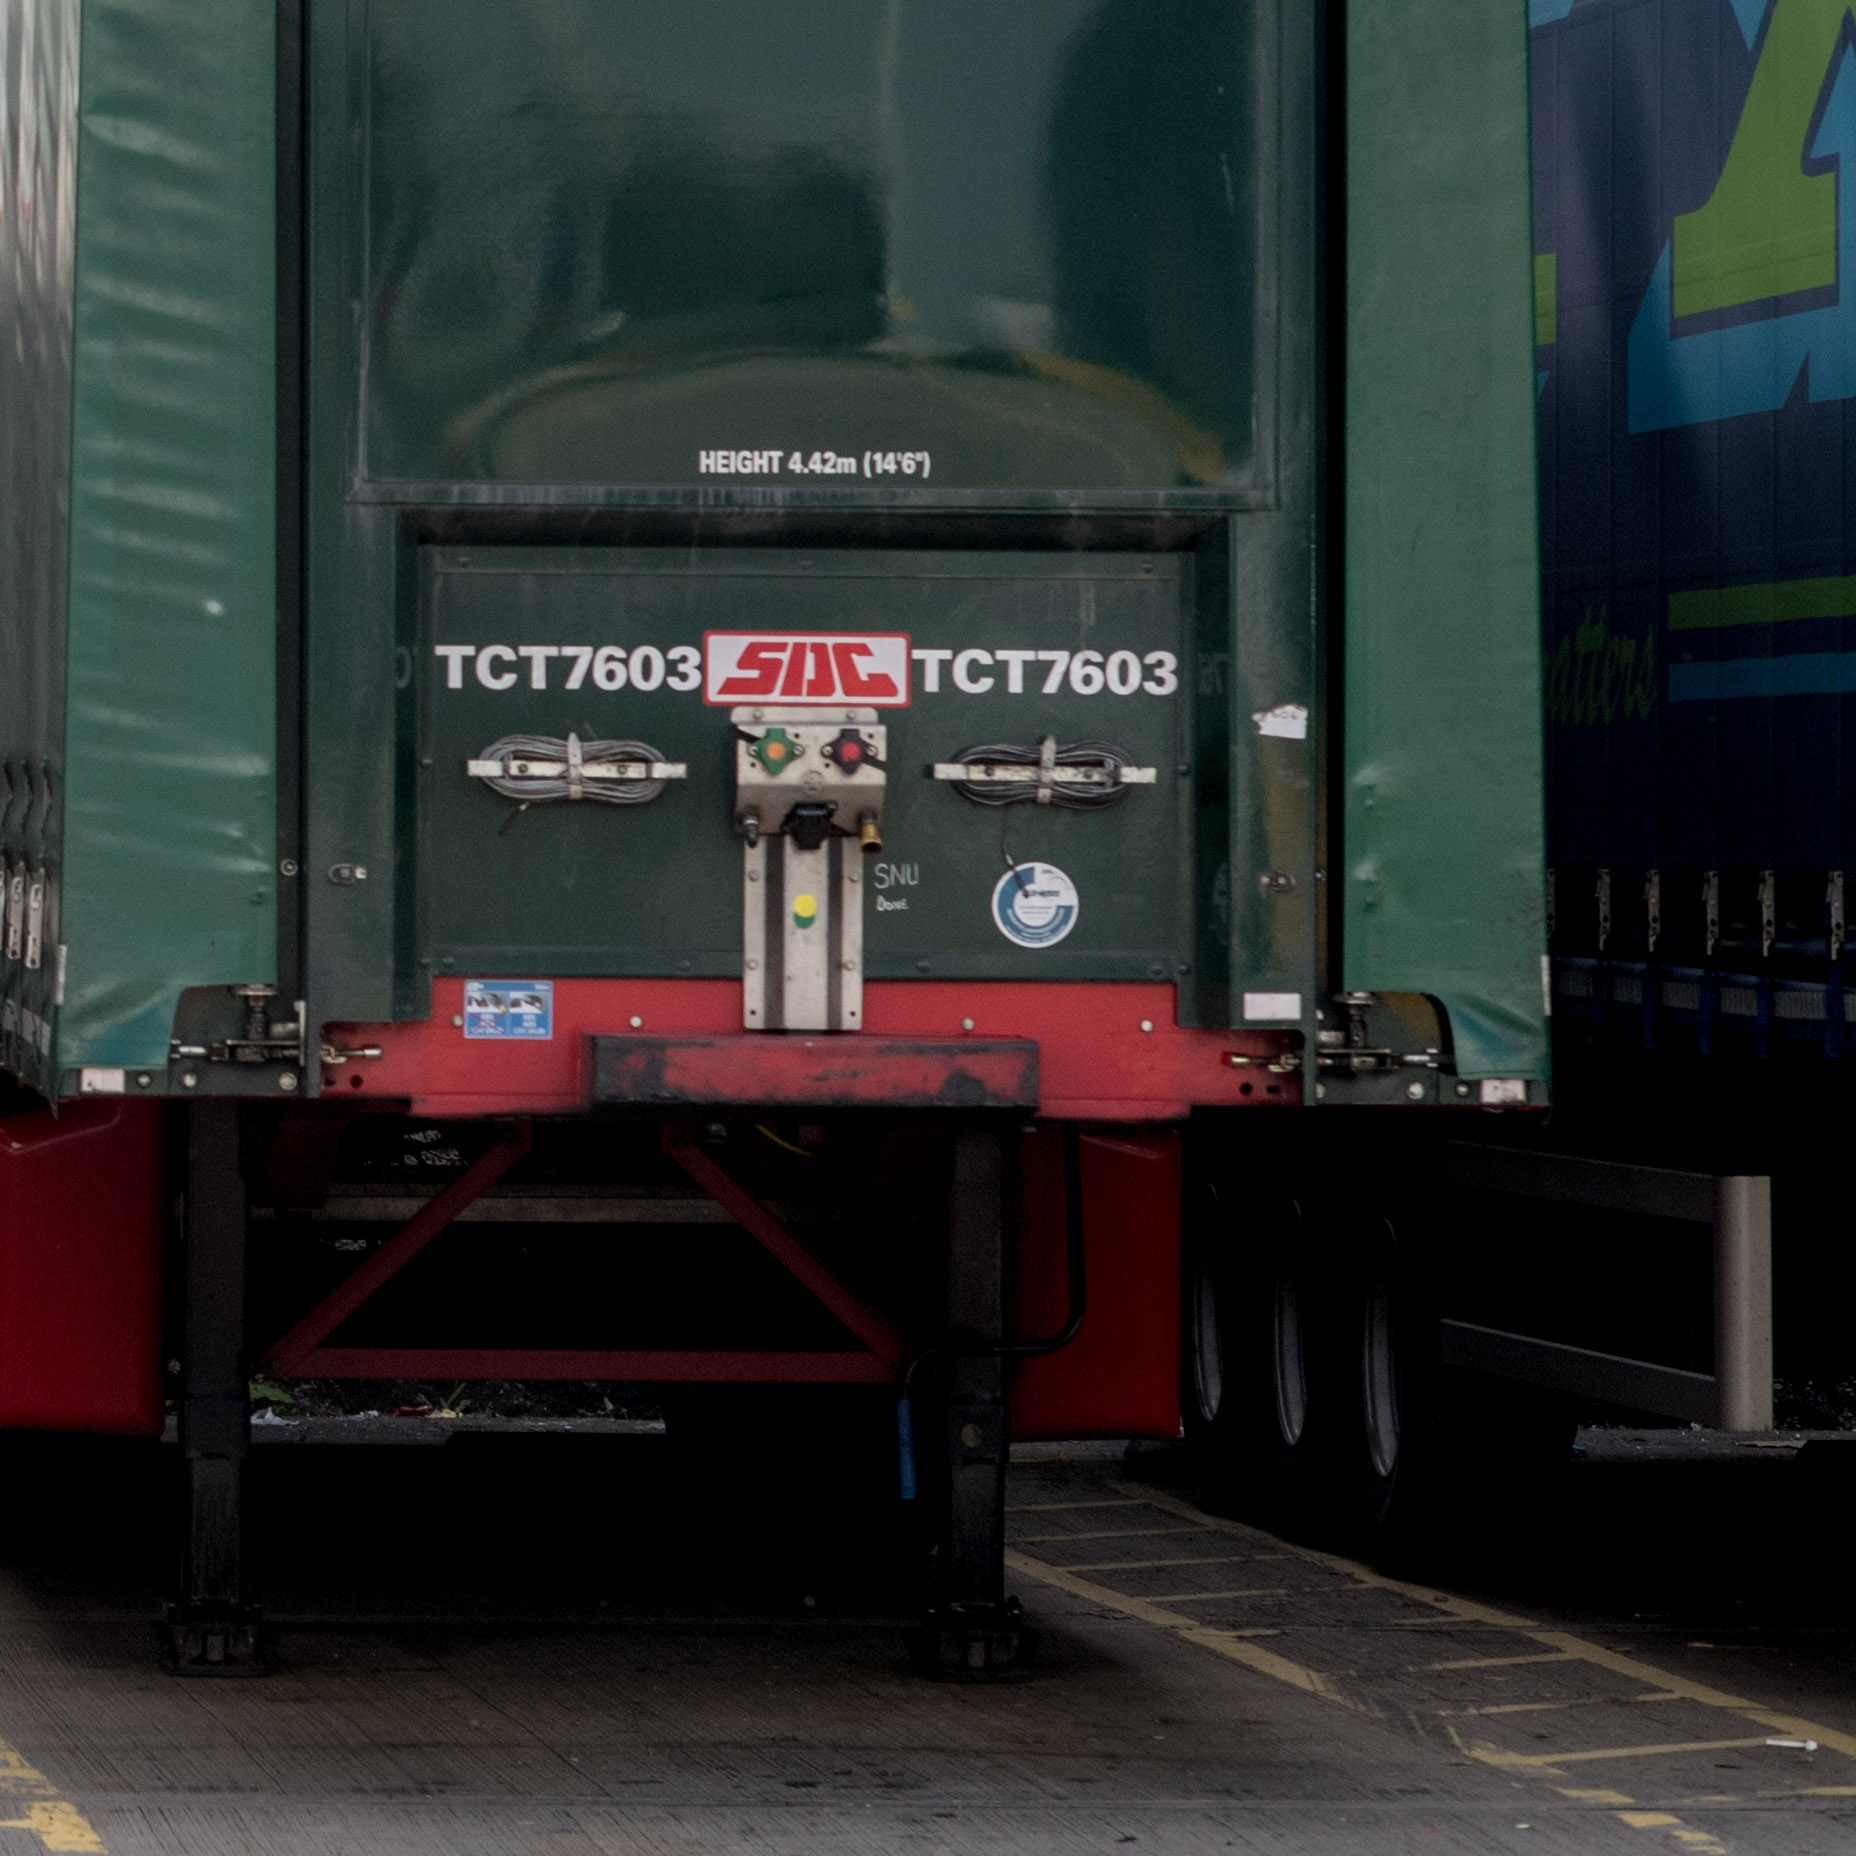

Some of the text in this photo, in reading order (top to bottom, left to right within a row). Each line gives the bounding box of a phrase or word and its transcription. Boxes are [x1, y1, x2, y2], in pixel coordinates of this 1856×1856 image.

[699, 449, 784, 474] HEIGHT
[788, 450, 858, 475] 4.42m
[433, 644, 703, 692] TCT7603
[717, 641, 900, 698] SDC
[910, 648, 1179, 696] TCT7603
[873, 862, 920, 889] SNU
